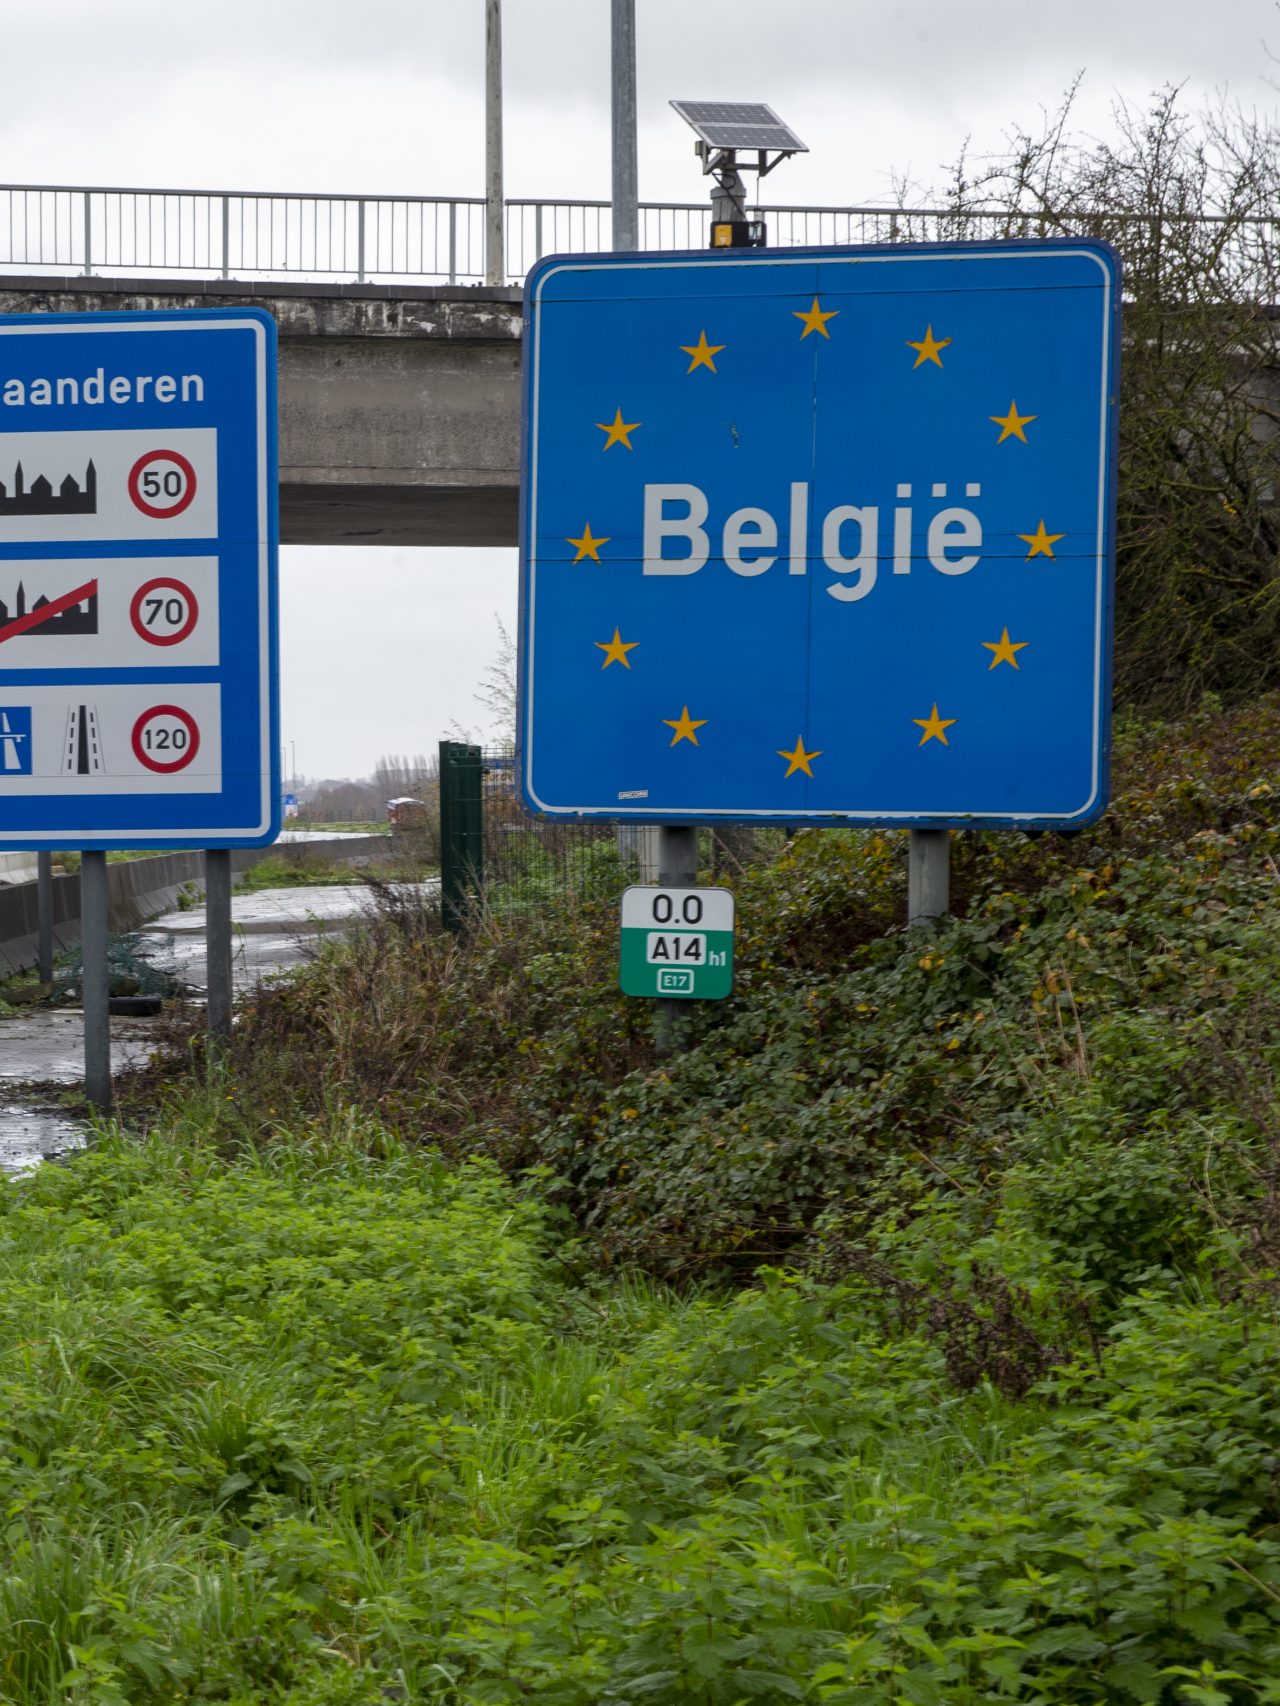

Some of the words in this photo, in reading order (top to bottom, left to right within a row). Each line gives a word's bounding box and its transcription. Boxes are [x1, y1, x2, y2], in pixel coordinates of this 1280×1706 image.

[143, 471, 182, 497] 50
[643, 482, 983, 602] België
[145, 599, 184, 625] 70
[144, 728, 187, 750] 120
[653, 894, 703, 924] 0.0
[652, 937, 702, 961] A14
[664, 975, 687, 987] E17
